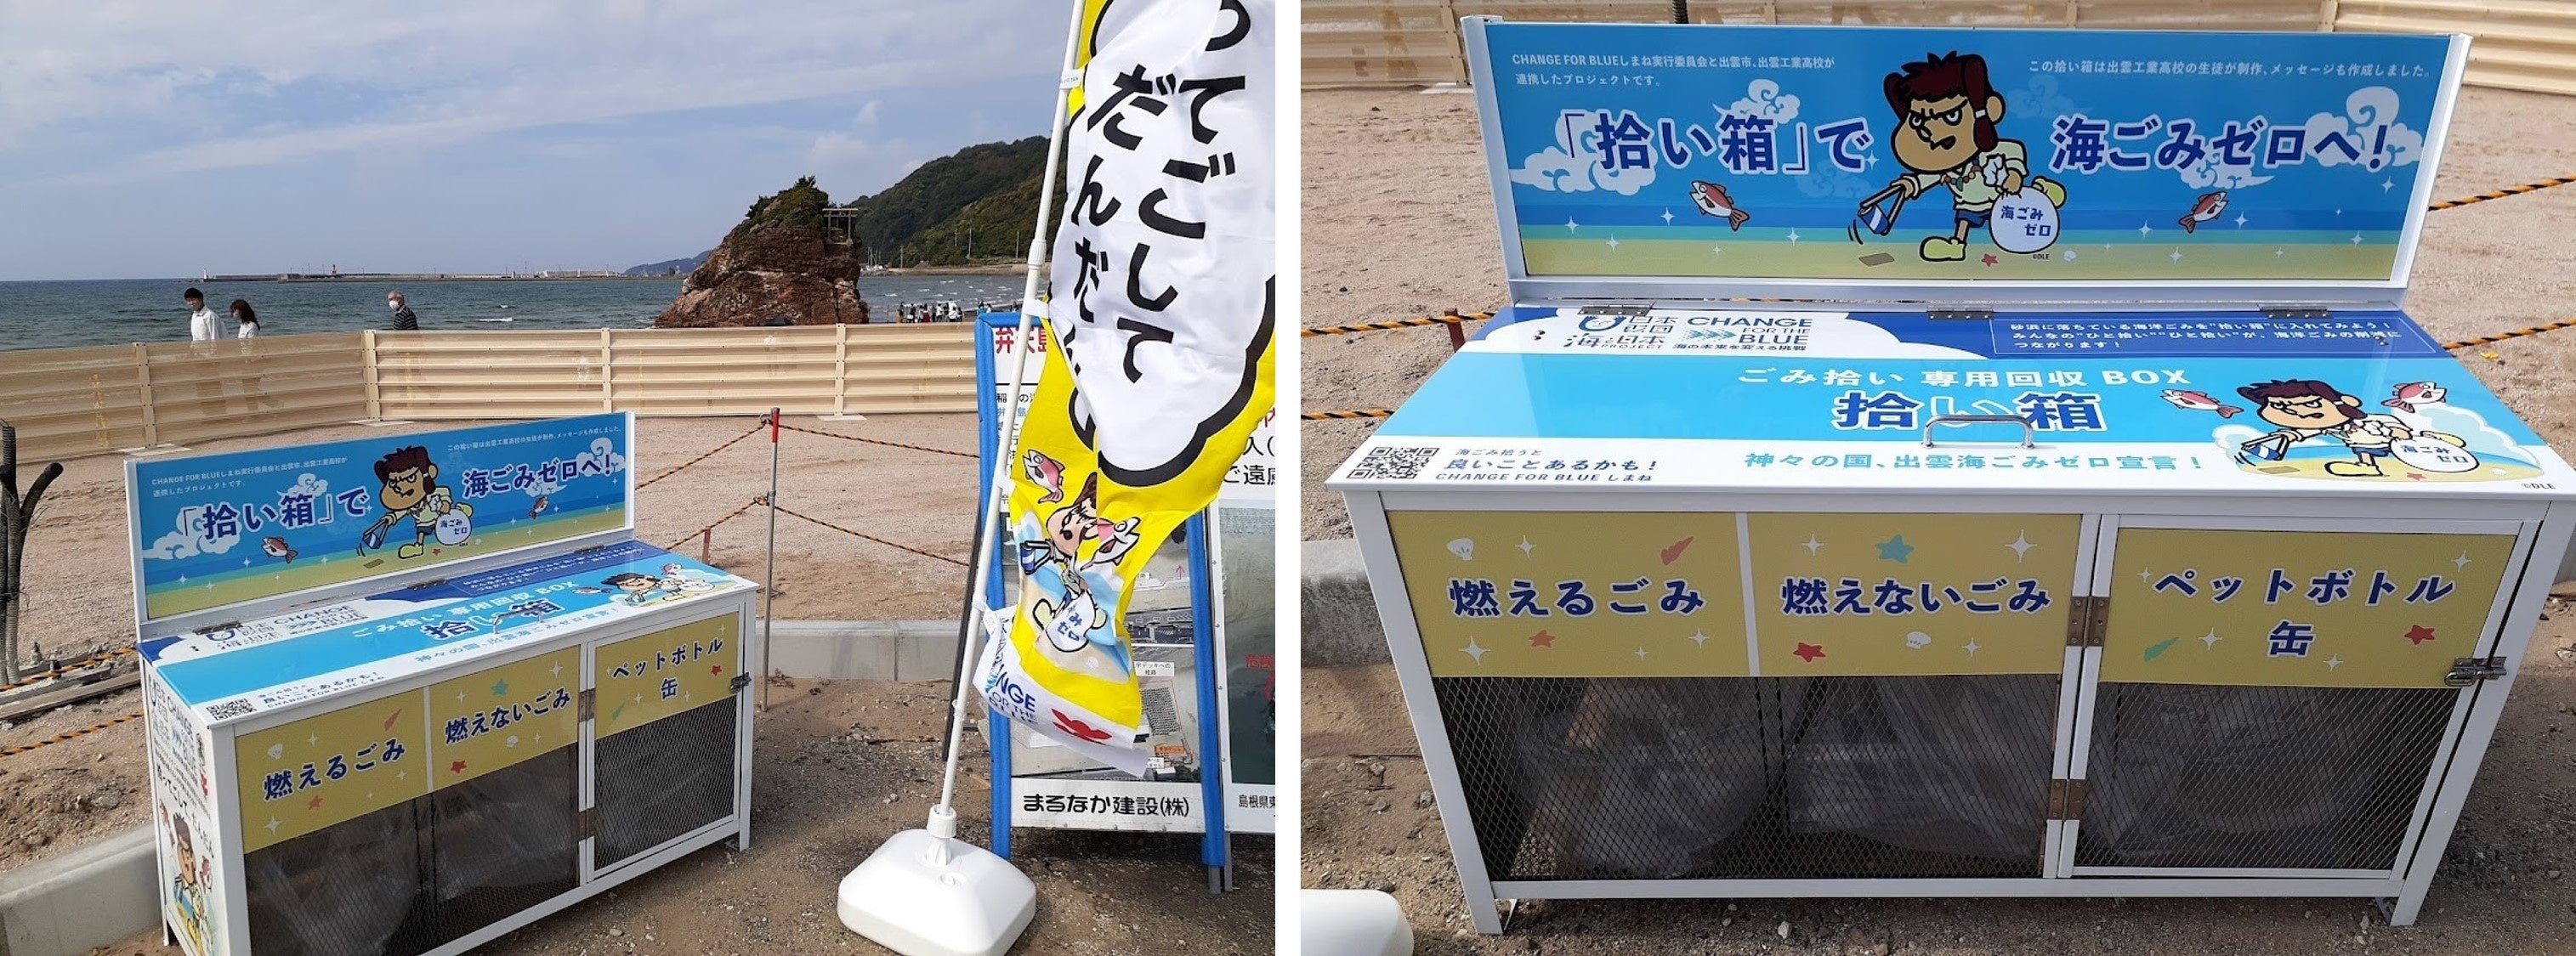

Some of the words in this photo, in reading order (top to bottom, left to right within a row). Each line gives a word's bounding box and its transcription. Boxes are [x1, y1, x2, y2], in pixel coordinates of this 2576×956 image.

[1512, 54, 1561, 65] CHANGE
[1563, 54, 1587, 65] FOR
[1515, 73, 1660, 86] 連携したプロジェクトです。
[1563, 110, 1874, 173] 「拾い箱」で
[2052, 116, 2388, 172] 海ごみゼロへ！
[2000, 205, 2044, 220] 海ごみ
[2024, 223, 2051, 236] ゼロ
[1688, 317, 1813, 327] CHANGE
[1739, 334, 1809, 344] BLUE
[1738, 367, 1904, 387] ごみ拾い
[1921, 368, 2088, 389] 専用回収
[2102, 369, 2192, 387] BOX
[1834, 391, 2108, 432] 拾い箱
[2401, 445, 2450, 454] 海ごみ
[463, 455, 611, 498] 海ごみゼロへ！
[1444, 459, 1657, 471] 良いことあるかも！
[151, 473, 184, 485] CHANGE
[184, 472, 201, 483] FOR
[181, 488, 368, 540] 「拾い箱」で
[535, 580, 580, 595] BOX
[1450, 576, 1705, 618] 燃えるごみ
[1781, 576, 2051, 617] 燃えないごみ
[2153, 567, 2455, 605] ペットボトル
[2267, 620, 2315, 656] 缶
[612, 637, 723, 678] ペットボトル
[661, 678, 678, 700] 缶
[445, 687, 571, 745] 燃えないごみ
[264, 738, 406, 801] 燃えるごみ
[1024, 794, 1189, 817] まるなか建設(株)
